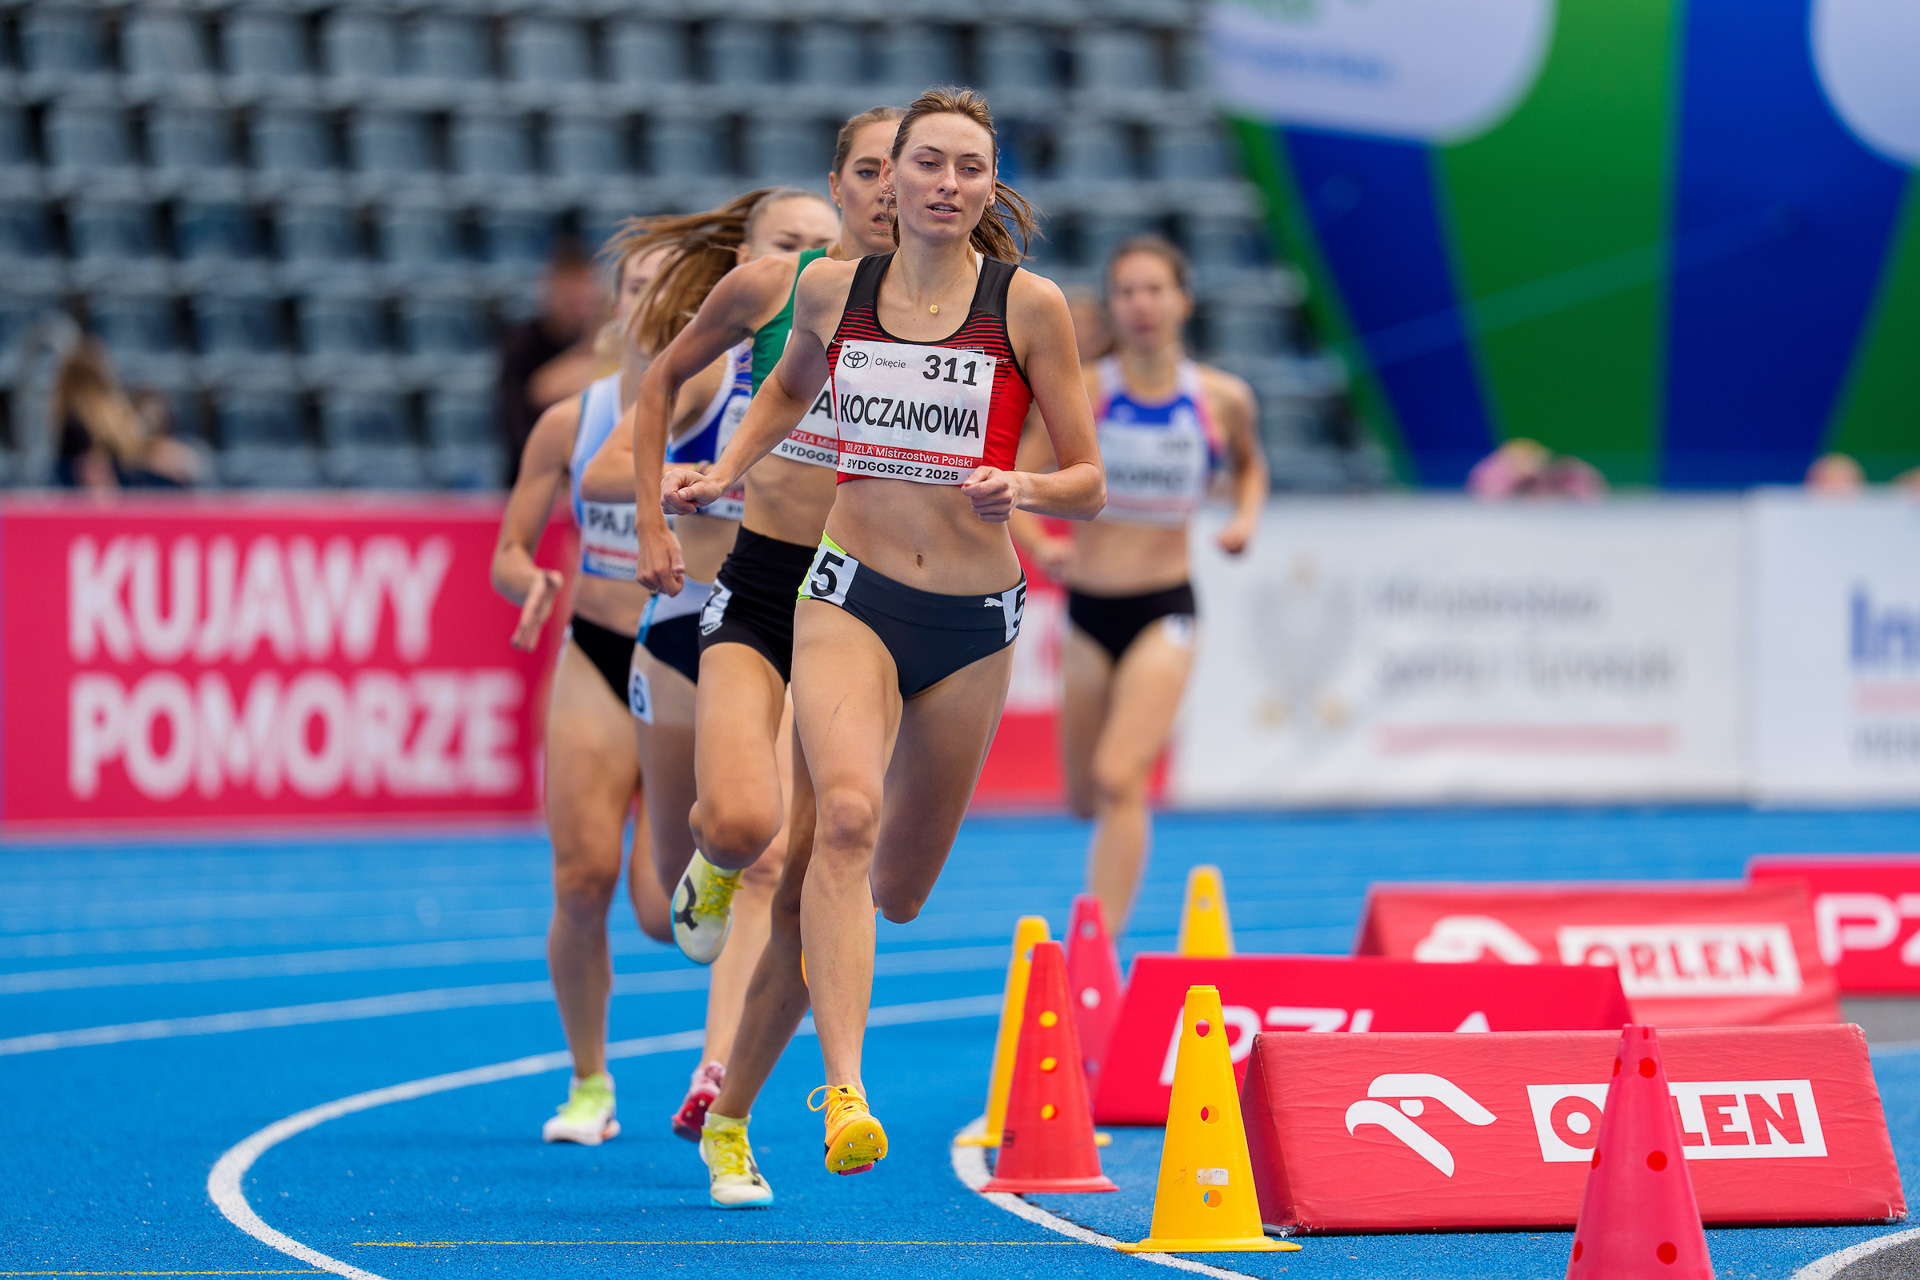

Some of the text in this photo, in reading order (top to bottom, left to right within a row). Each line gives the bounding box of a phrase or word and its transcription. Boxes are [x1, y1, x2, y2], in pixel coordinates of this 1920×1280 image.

[875, 357, 907, 369] Okęcie
[922, 354, 978, 386] 311
[840, 393, 980, 439] KOCZANOWA
[847, 458, 959, 481] BYDGOSZCZ 2025
[875, 447, 940, 464] Mistrzostwa
[941, 455, 974, 468] Polski
[588, 506, 638, 538] PAJ
[810, 551, 846, 597] 5
[69, 535, 454, 663] KUJAWY
[69, 670, 524, 801] POMORZE
[1584, 941, 1777, 980] ORLEN
[1549, 1092, 1806, 1150] OLEN
